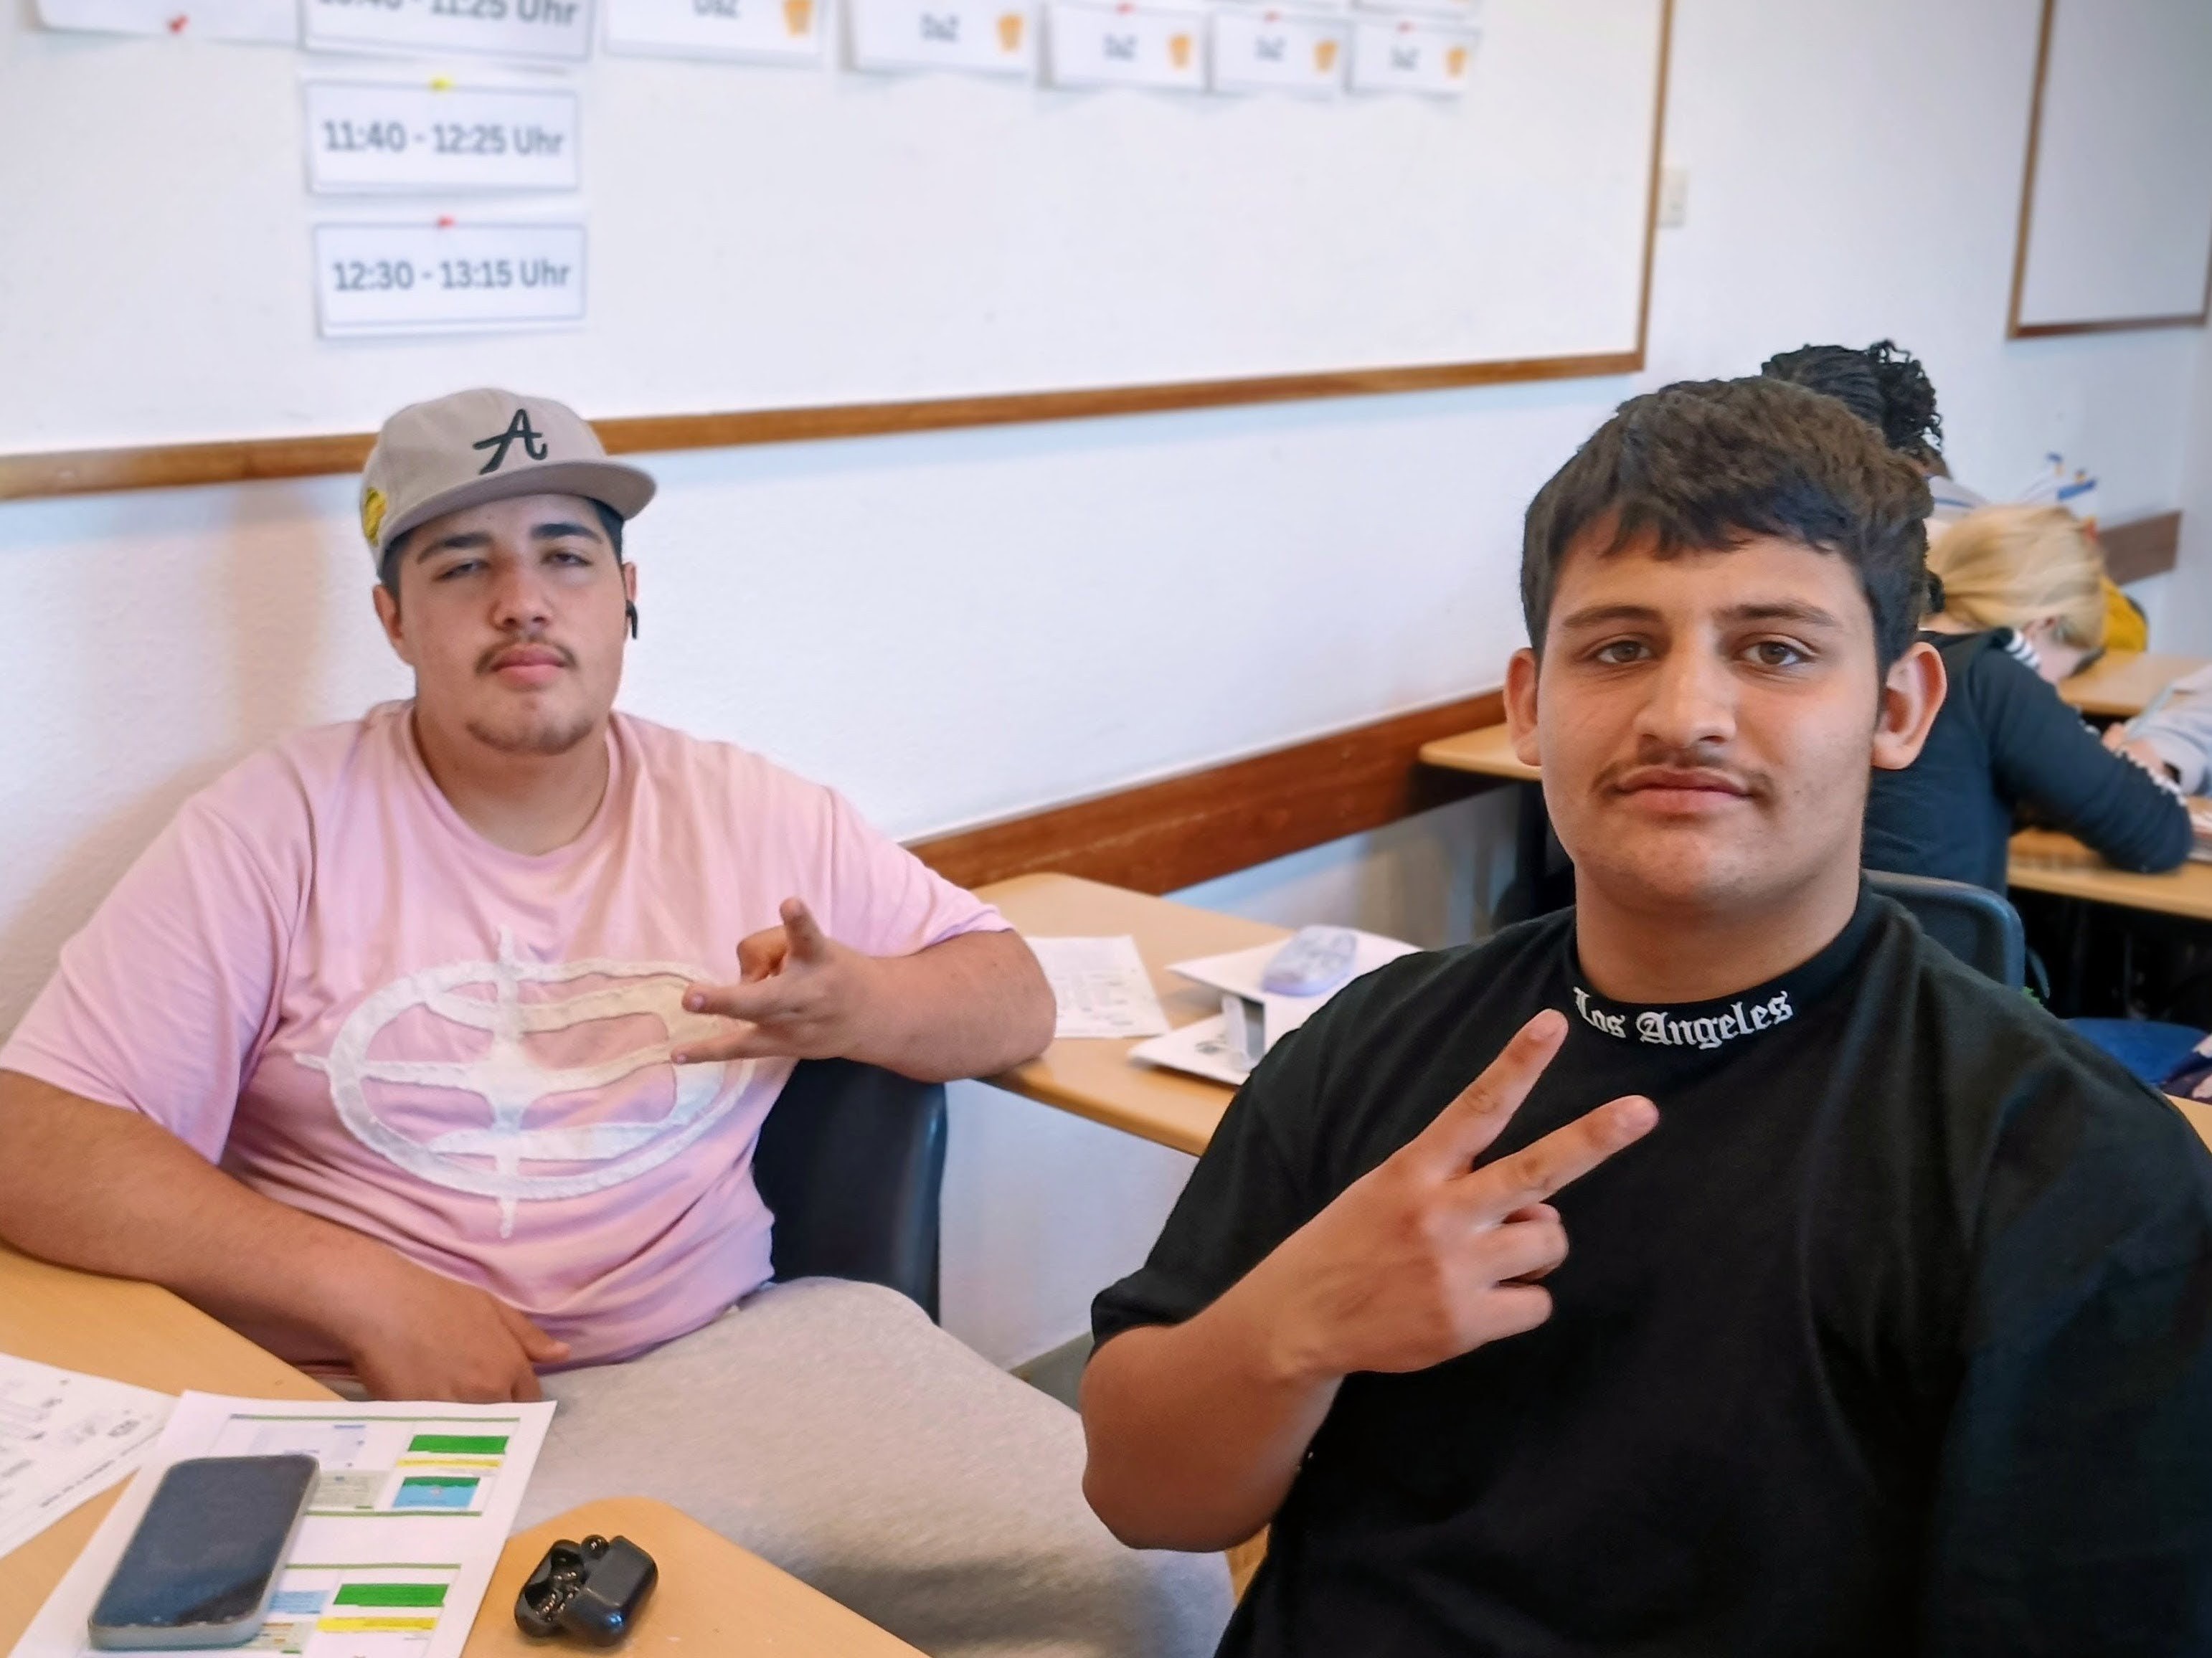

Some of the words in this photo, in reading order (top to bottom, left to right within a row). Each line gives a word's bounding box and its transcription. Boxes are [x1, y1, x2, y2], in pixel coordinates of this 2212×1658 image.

[517, 0, 578, 24] Uhr
[321, 120, 407, 153] 11:40
[433, 123, 506, 155] 12:25
[512, 125, 563, 155] Uhr
[332, 260, 415, 291] 12:30
[440, 259, 514, 290] 13:15
[520, 257, 570, 288] Uhr
[472, 408, 549, 475] A
[1573, 986, 1627, 1038] Los
[1635, 990, 1793, 1051] Angeles
